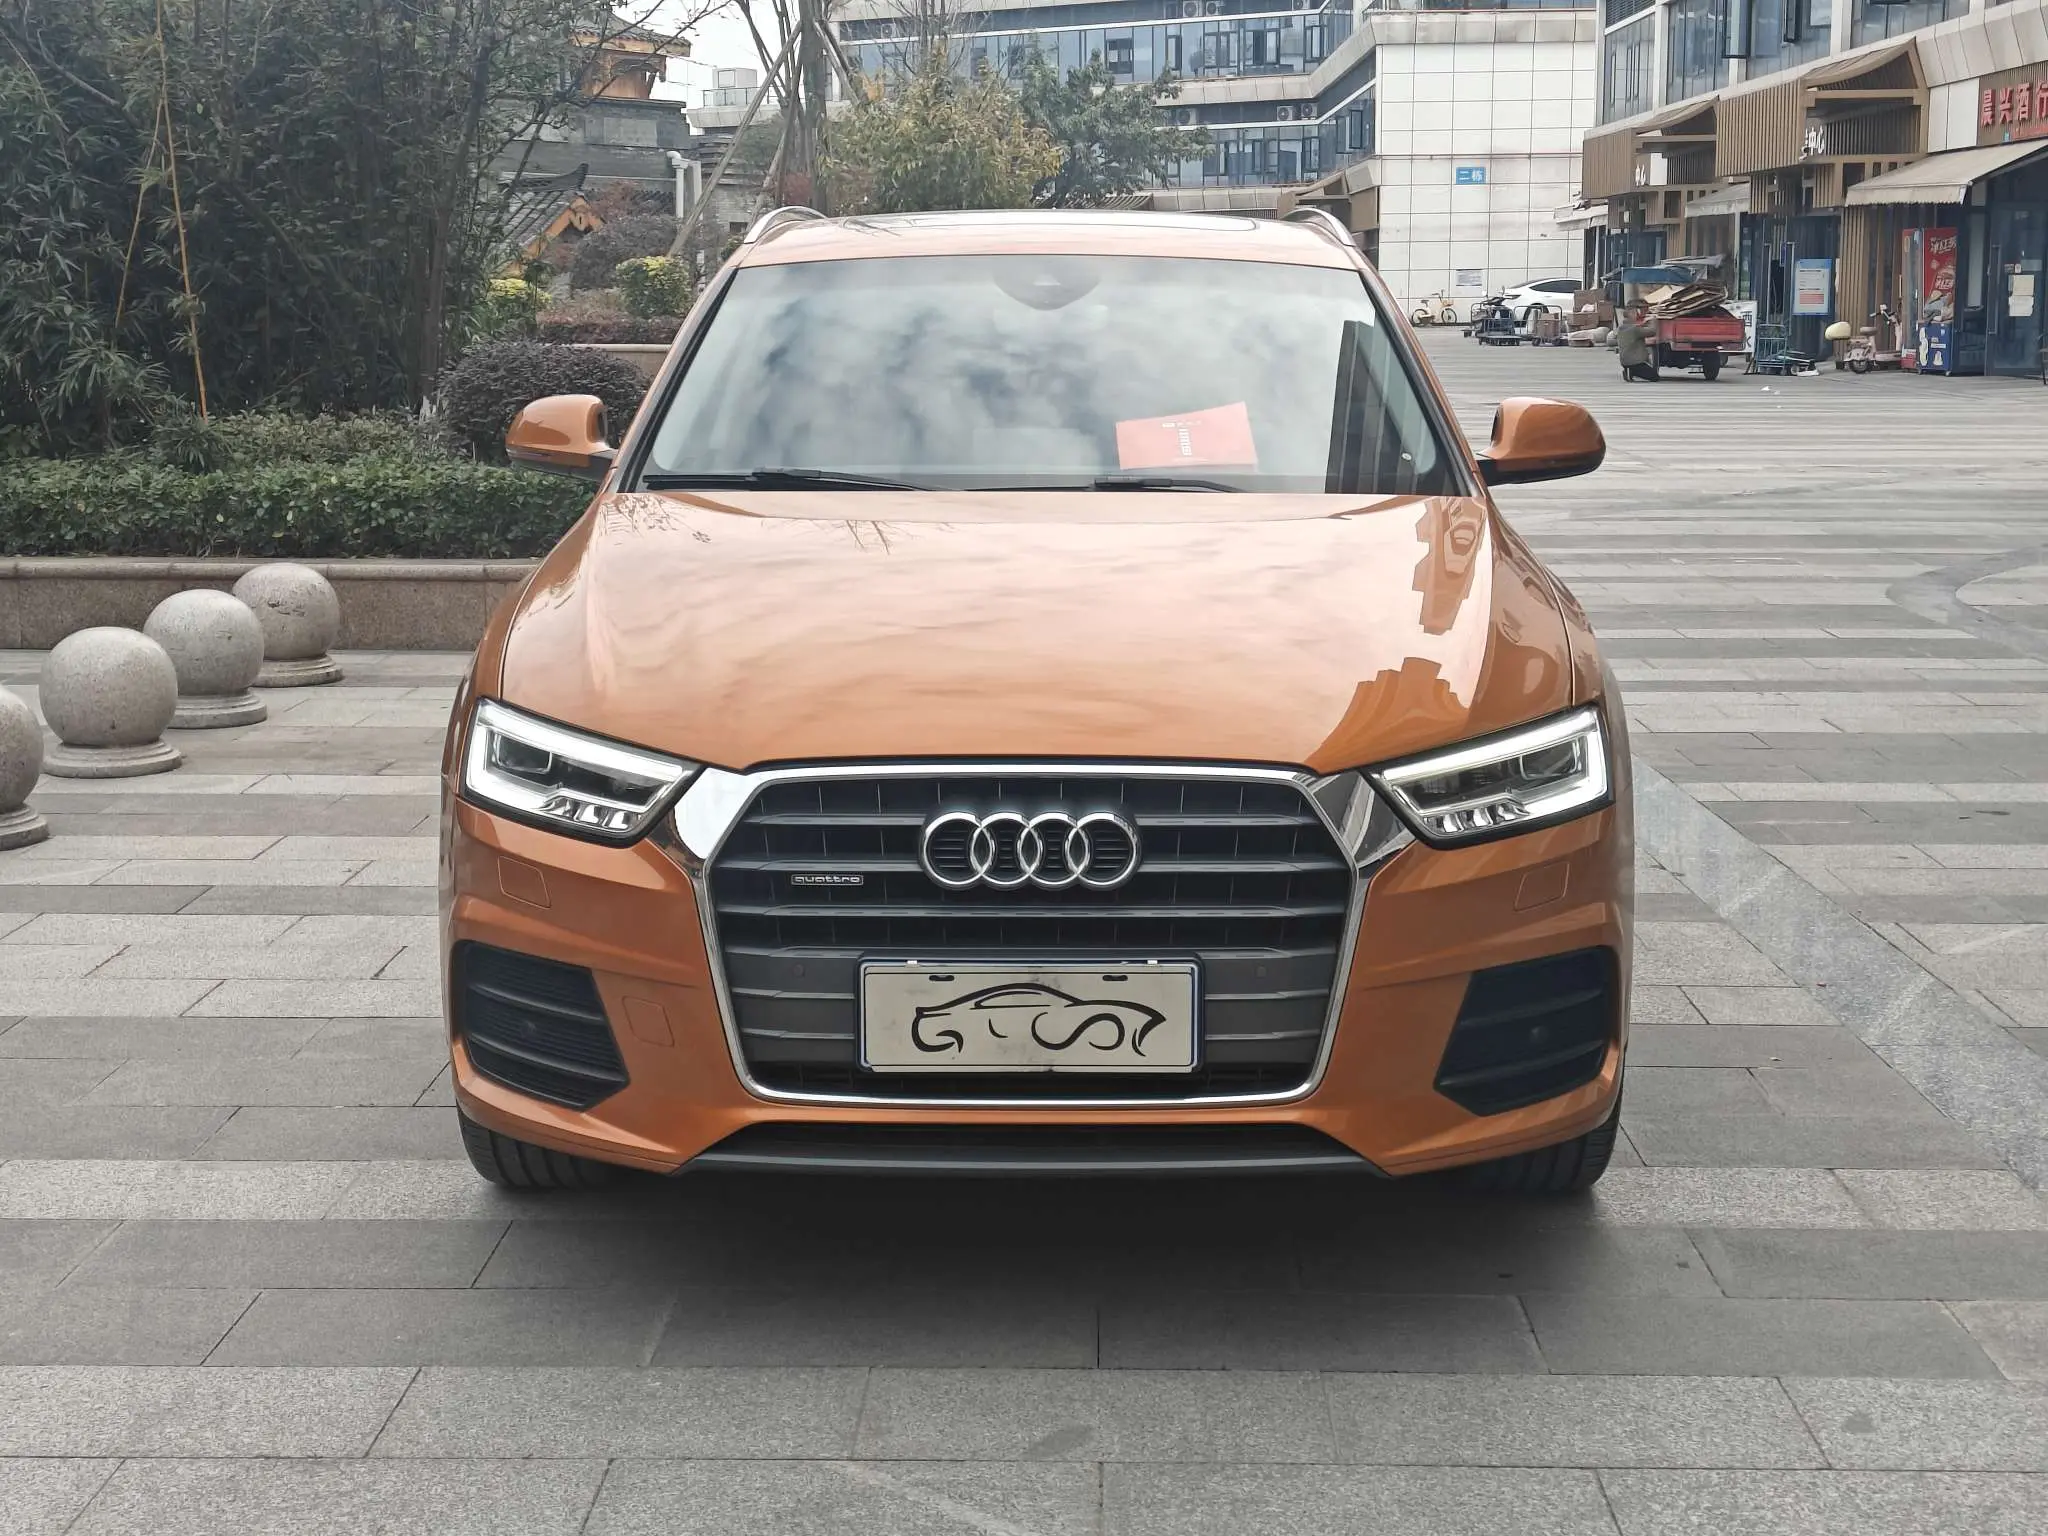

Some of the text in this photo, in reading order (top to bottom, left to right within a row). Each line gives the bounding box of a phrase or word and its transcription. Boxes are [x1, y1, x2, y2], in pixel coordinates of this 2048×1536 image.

[1980, 81, 2048, 128] 晨兴酒行
[794, 875, 860, 884] quattro
